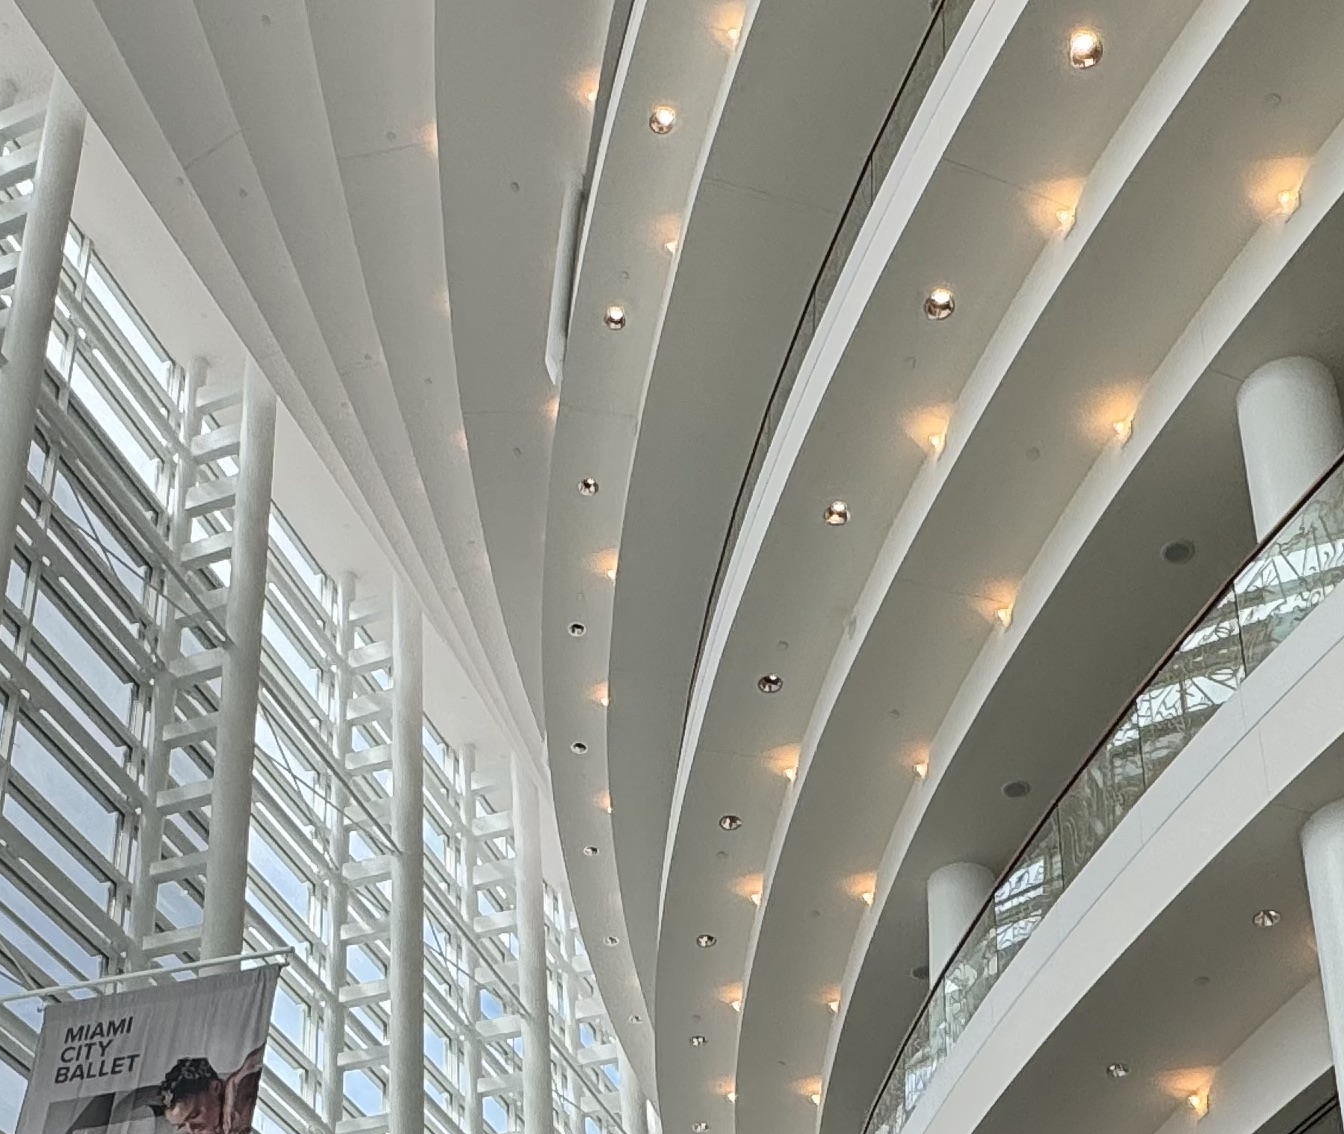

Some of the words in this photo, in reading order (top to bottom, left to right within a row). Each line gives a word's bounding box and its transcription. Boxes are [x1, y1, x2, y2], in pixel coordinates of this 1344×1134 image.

[64, 1016, 134, 1044] MIAMI
[60, 1040, 114, 1063] CITY
[55, 1054, 140, 1084] BALLET
